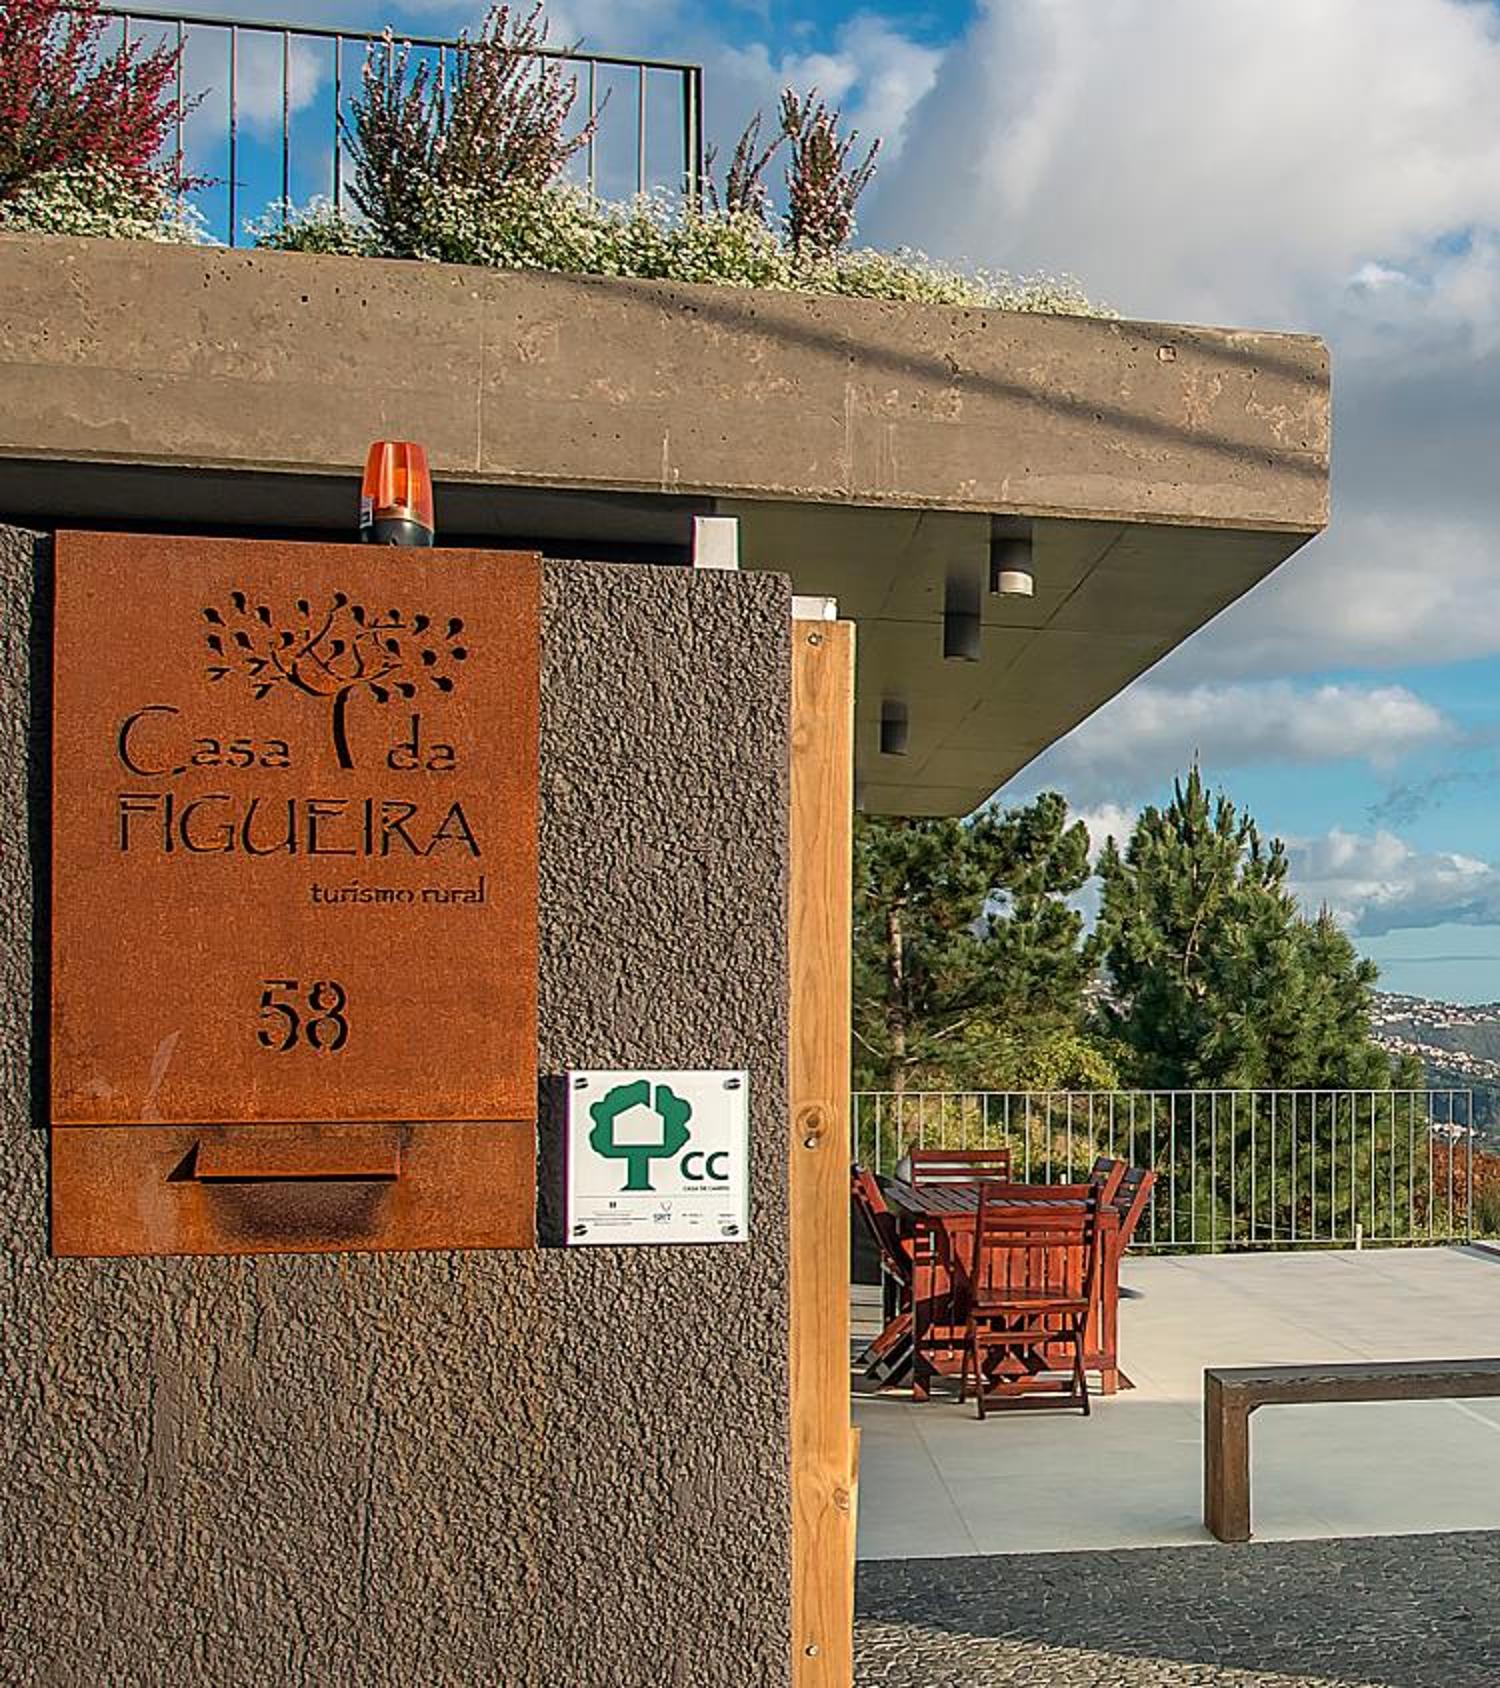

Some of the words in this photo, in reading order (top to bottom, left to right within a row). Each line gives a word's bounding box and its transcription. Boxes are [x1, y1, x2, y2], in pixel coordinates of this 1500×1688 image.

[118, 705, 290, 775] Casa
[388, 714, 456, 771] da
[118, 792, 481, 857] FIGUEIRA
[421, 875, 485, 904] rural
[257, 980, 348, 1051] 58
[680, 1151, 729, 1181] CC
